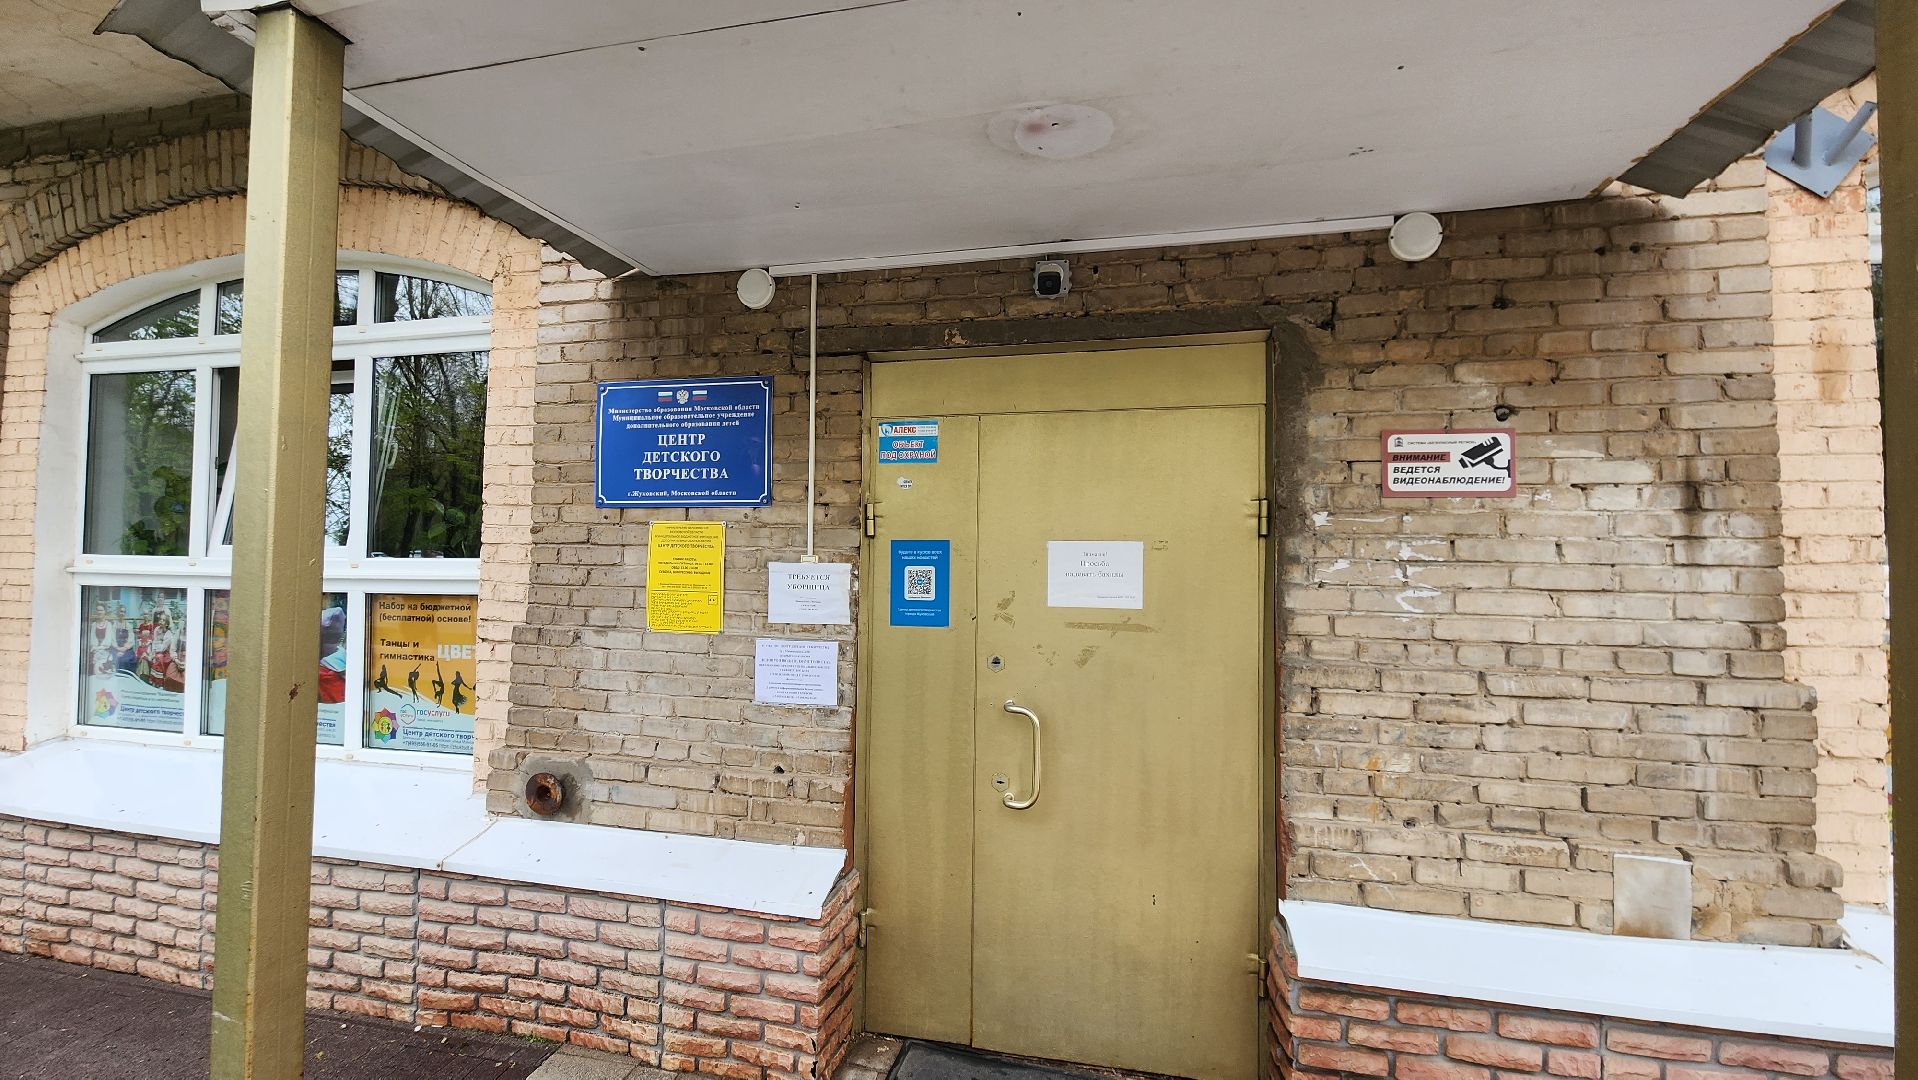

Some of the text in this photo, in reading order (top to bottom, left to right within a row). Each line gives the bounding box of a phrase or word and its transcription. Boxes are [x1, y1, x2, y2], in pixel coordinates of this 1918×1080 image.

[663, 413, 716, 421] образовательное
[657, 433, 706, 446] ЦЕНТР
[892, 440, 924, 448] ОБЪЕКТ
[642, 450, 721, 464] ДЕТСКОГО
[880, 449, 936, 460] ПОД ОХРАНОЙ
[634, 468, 728, 480] ТВОРЧЕСТВА
[1393, 466, 1440, 475] ВЕДЕТСЯ
[1392, 476, 1506, 486] ВИДЕОНАБЛЮДЕНИЕ!
[379, 602, 405, 611] Набор
[420, 603, 471, 612] бюджетной
[380, 613, 434, 623] (бесплатной)
[380, 639, 410, 648] Танцы
[380, 653, 435, 661] гимнастика
[403, 729, 423, 737] Центр
[424, 731, 455, 739] детского
